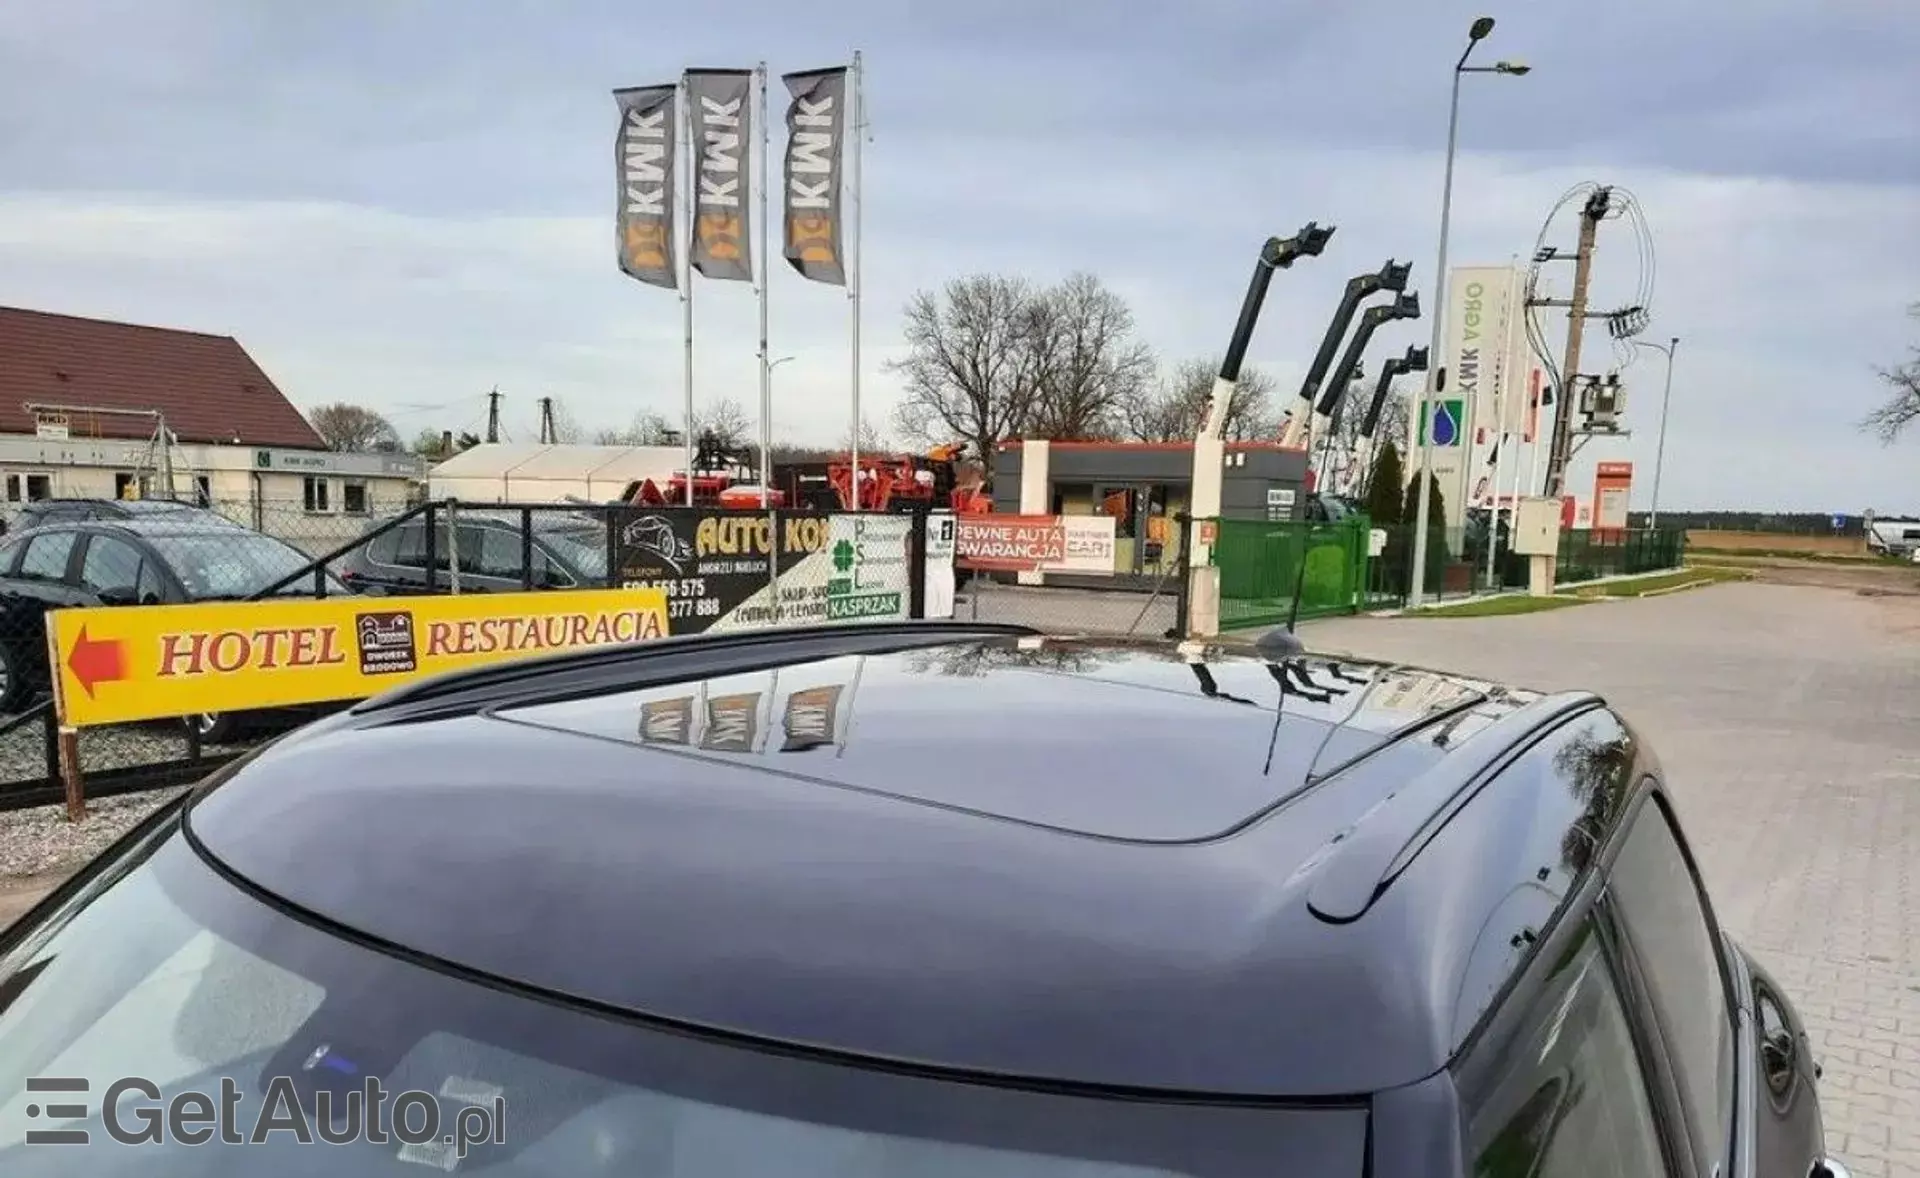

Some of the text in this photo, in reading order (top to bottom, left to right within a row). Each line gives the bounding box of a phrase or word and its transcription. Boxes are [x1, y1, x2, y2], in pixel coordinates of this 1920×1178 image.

[626, 107, 664, 214] KWK
[700, 96, 740, 206] KWK
[791, 97, 832, 208] KWK
[696, 517, 775, 557] AUTO
[1015, 528, 1062, 542] AUTA
[681, 579, 705, 597] 575
[831, 596, 897, 617] KASPRZAK
[157, 627, 345, 676] HOTEL
